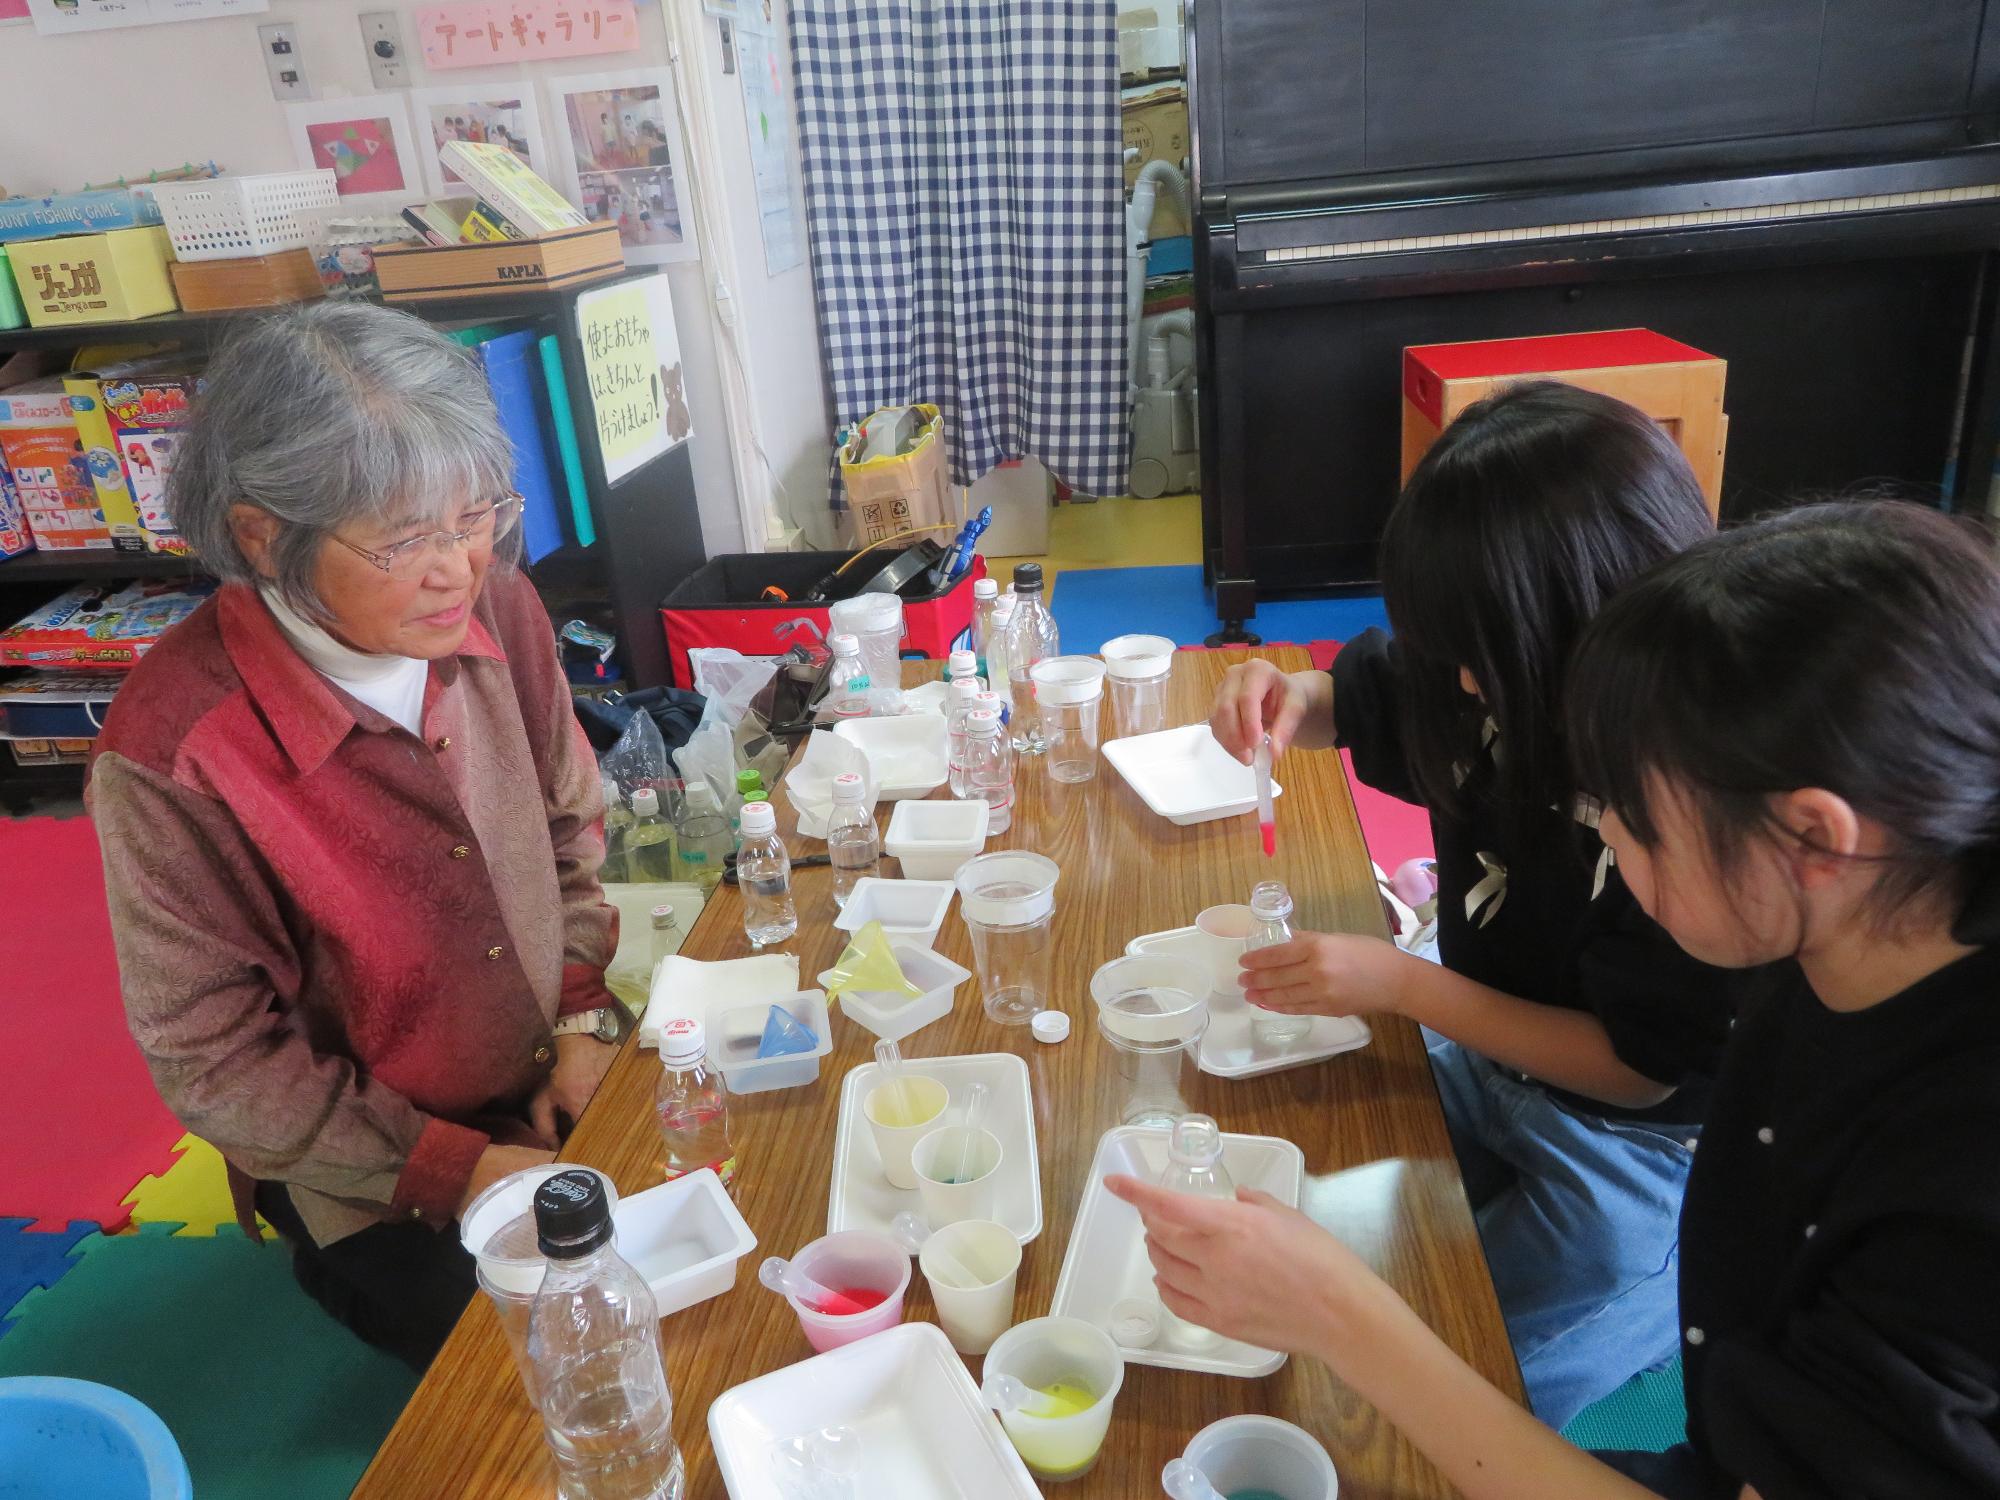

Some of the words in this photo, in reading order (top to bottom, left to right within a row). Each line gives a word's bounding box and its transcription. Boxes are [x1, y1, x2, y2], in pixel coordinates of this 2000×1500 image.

[435, 9, 622, 56] アートギャラリー
[34, 206, 82, 225] FISHING
[85, 202, 121, 219] GAME
[31, 260, 101, 300] ジェンガ
[496, 263, 544, 280] KAPLA
[60, 301, 89, 313] Jenga
